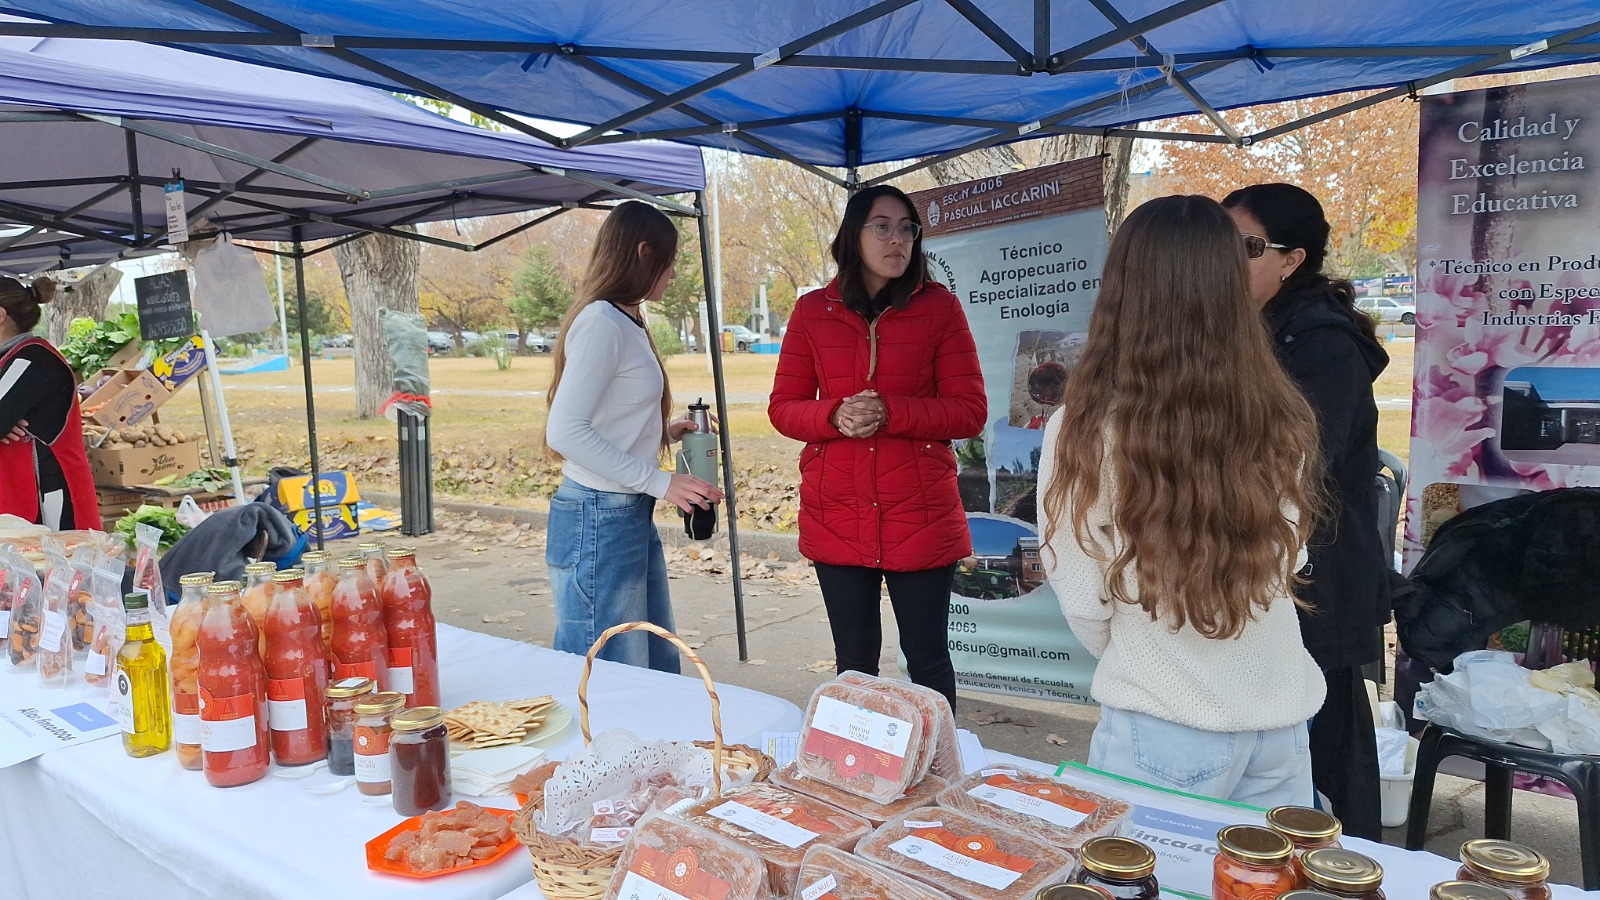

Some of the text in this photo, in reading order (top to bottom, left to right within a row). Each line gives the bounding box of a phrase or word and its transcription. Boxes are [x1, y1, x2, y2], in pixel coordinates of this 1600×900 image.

[1458, 113, 1581, 143] Calidad y
[1449, 151, 1585, 180] Excelencia
[972, 176, 1003, 196] 4.006
[944, 180, 1060, 223] PASCUAL IACCARINI
[1451, 190, 1579, 215] Educativa
[1000, 242, 1063, 261] Técnico
[980, 258, 1087, 285] Agropecuario
[1440, 259, 1512, 275] Técnico
[1518, 262, 1540, 272] en
[969, 278, 1101, 305] Especializado en
[1499, 284, 1600, 304] con Espec
[1000, 300, 1070, 320] Enología
[1482, 311, 1581, 326] Industrias
[948, 603, 970, 615] 300
[948, 621, 977, 634] 4063
[948, 639, 1070, 661] 06sup@gmail.com
[957, 678, 1001, 690] Educación
[1002, 682, 1037, 694] Técnica
[1045, 689, 1081, 700] Técnica
[1082, 695, 1088, 703] y
[985, 672, 1018, 682] General
[1021, 675, 1032, 684] de
[1033, 677, 1075, 689] Escuelas
